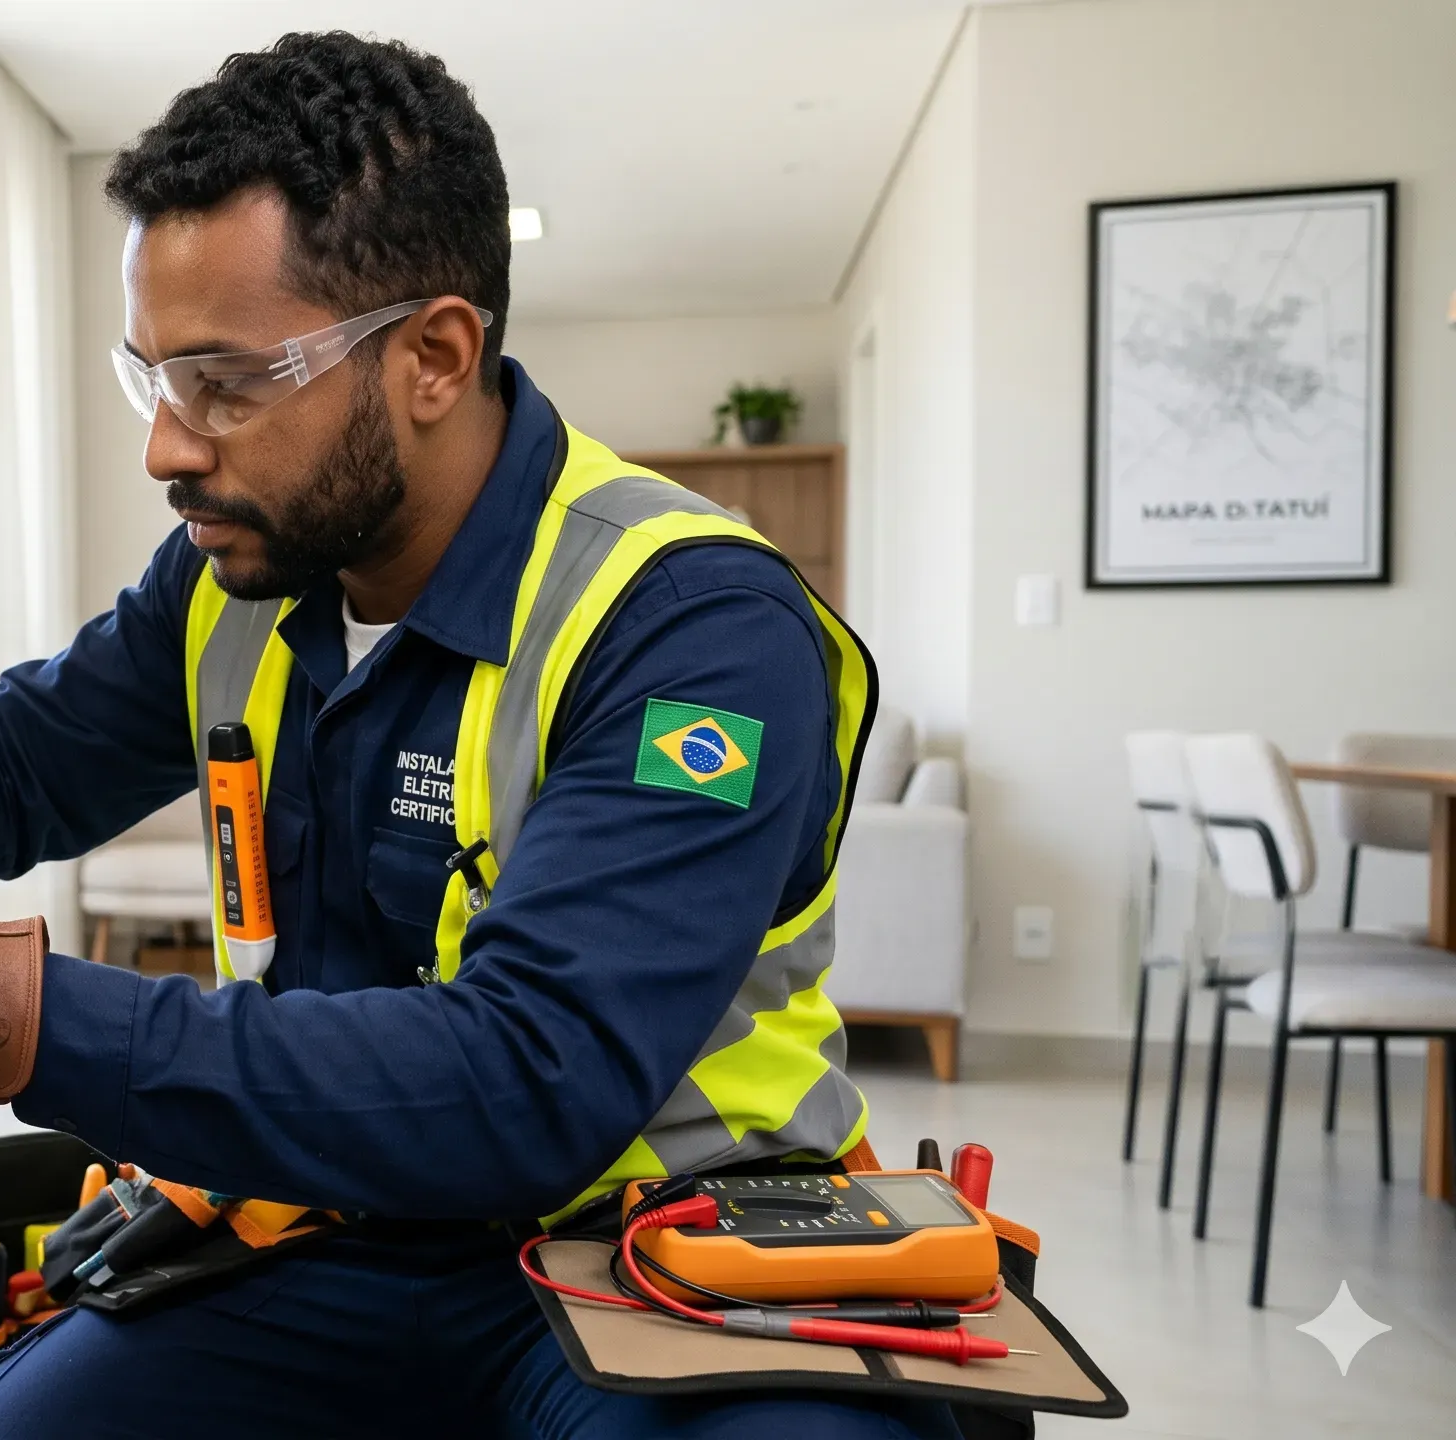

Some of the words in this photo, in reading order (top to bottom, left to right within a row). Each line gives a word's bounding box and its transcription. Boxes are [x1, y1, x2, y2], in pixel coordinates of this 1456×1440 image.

[1141, 501, 1217, 521] MAPA
[397, 751, 455, 776] INSTALA
[403, 774, 454, 801] ELÉTRI
[390, 797, 456, 826] CERTIFIC
